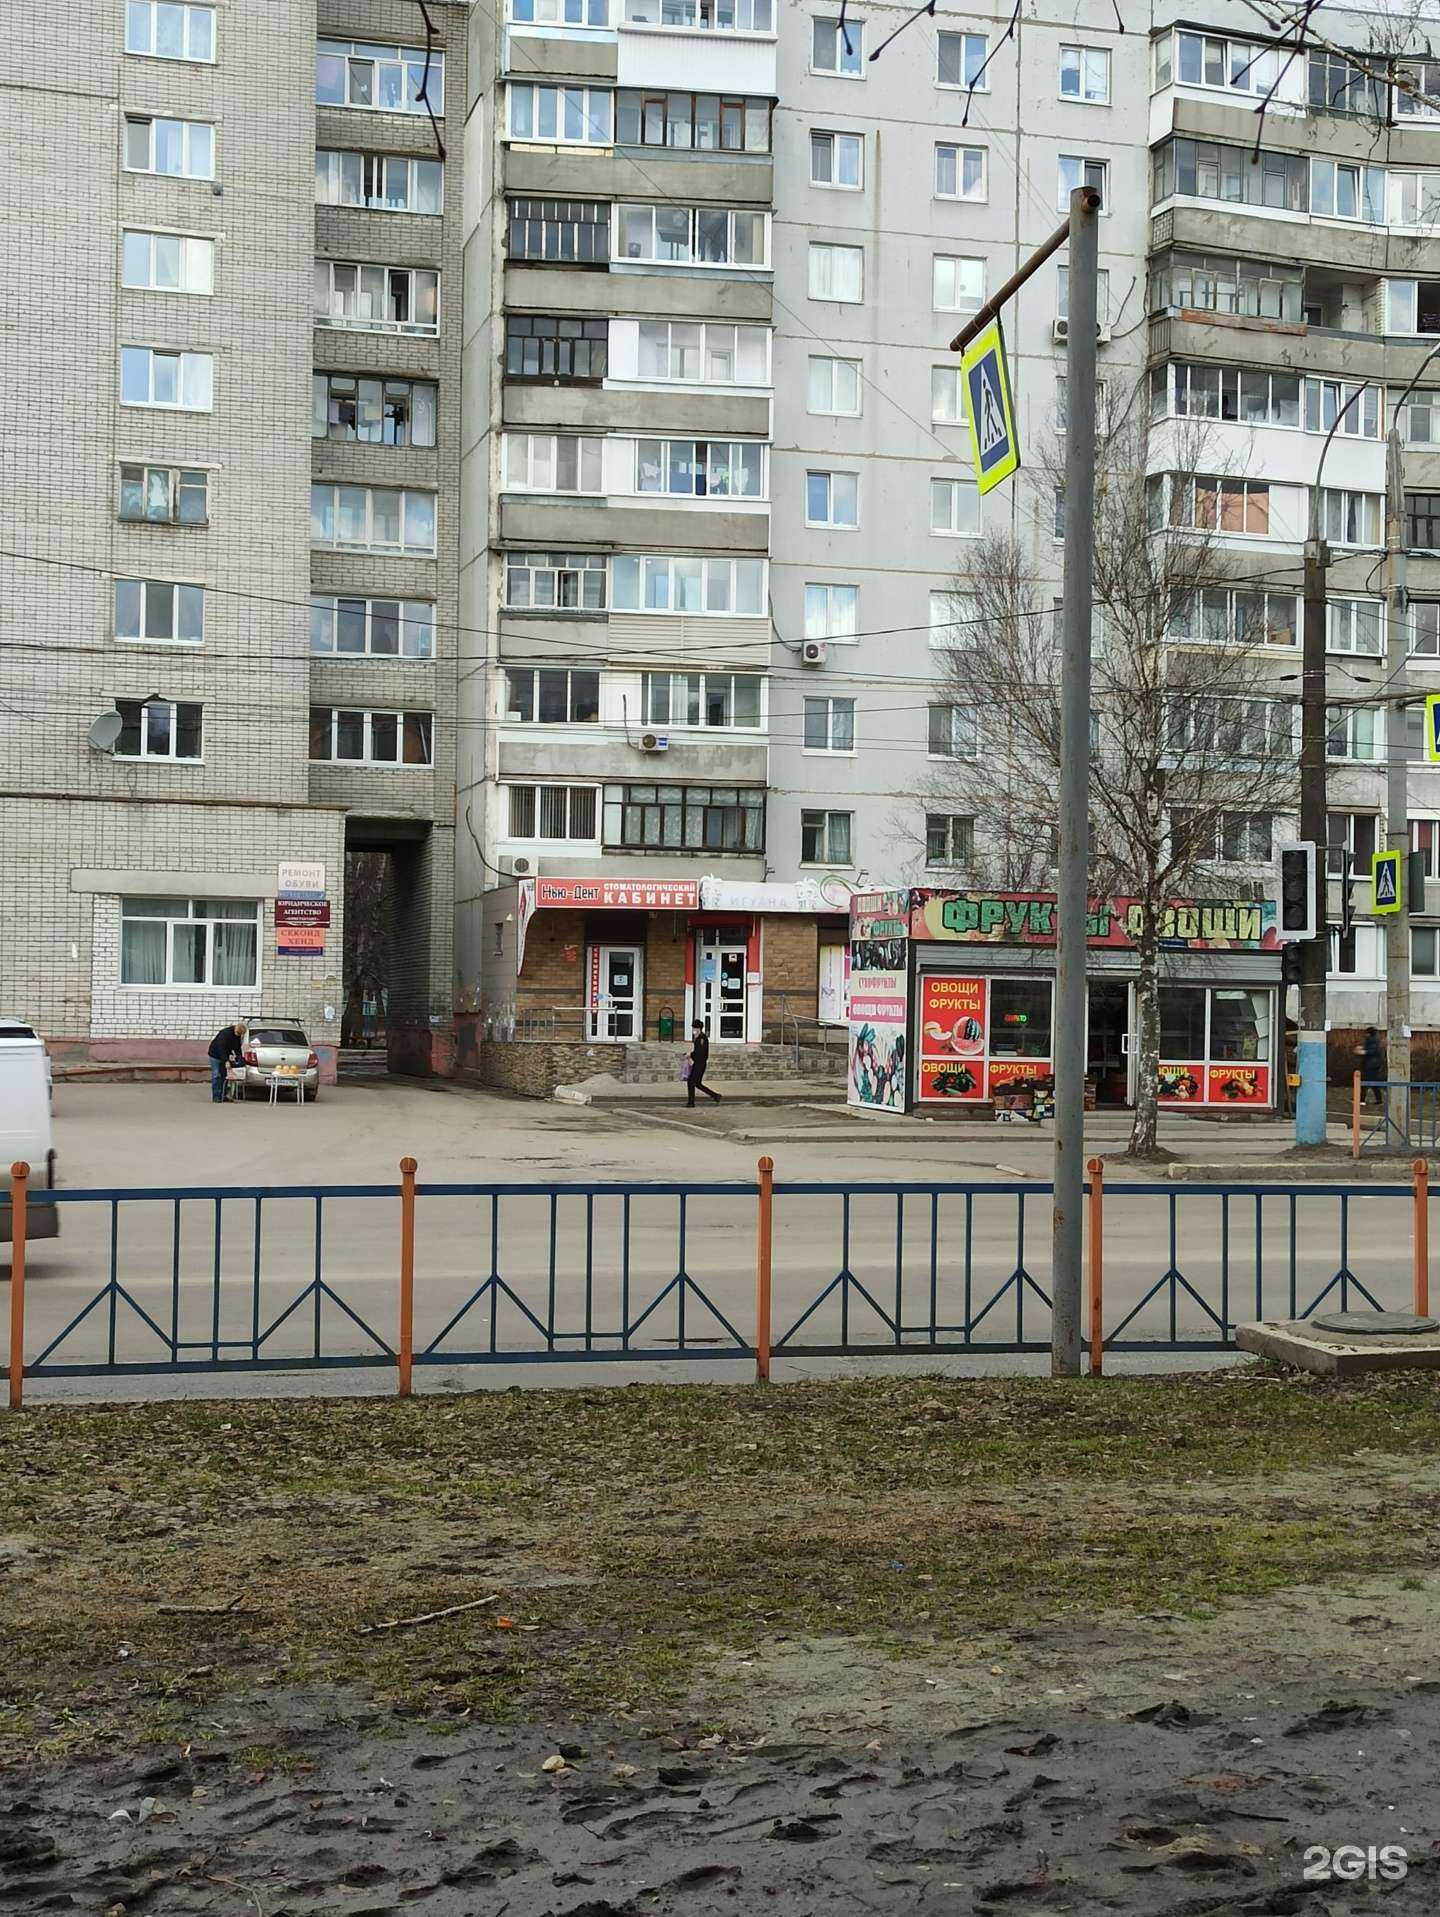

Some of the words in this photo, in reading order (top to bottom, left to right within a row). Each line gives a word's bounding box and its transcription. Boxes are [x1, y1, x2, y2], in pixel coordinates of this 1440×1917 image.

[281, 868, 321, 877] РЕМОНТ
[284, 879, 319, 888] ОБУВИ
[603, 883, 696, 892] СТОМАТОЛОГИЧЕСКИЙ
[542, 884, 599, 899] Нью-Дент
[603, 892, 696, 905] КАБИНЕТ
[942, 899, 1110, 937] ФРУКЫ
[931, 982, 978, 995] ОВОЩИ
[929, 999, 980, 1010] ФРУКТЫ
[922, 1063, 966, 1073] ОВОЩИ
[990, 1064, 1037, 1075] ФРУКТЫ
[1158, 1066, 1189, 1076] ОЩИ
[1210, 1069, 1255, 1079] ФРУКТЫ
